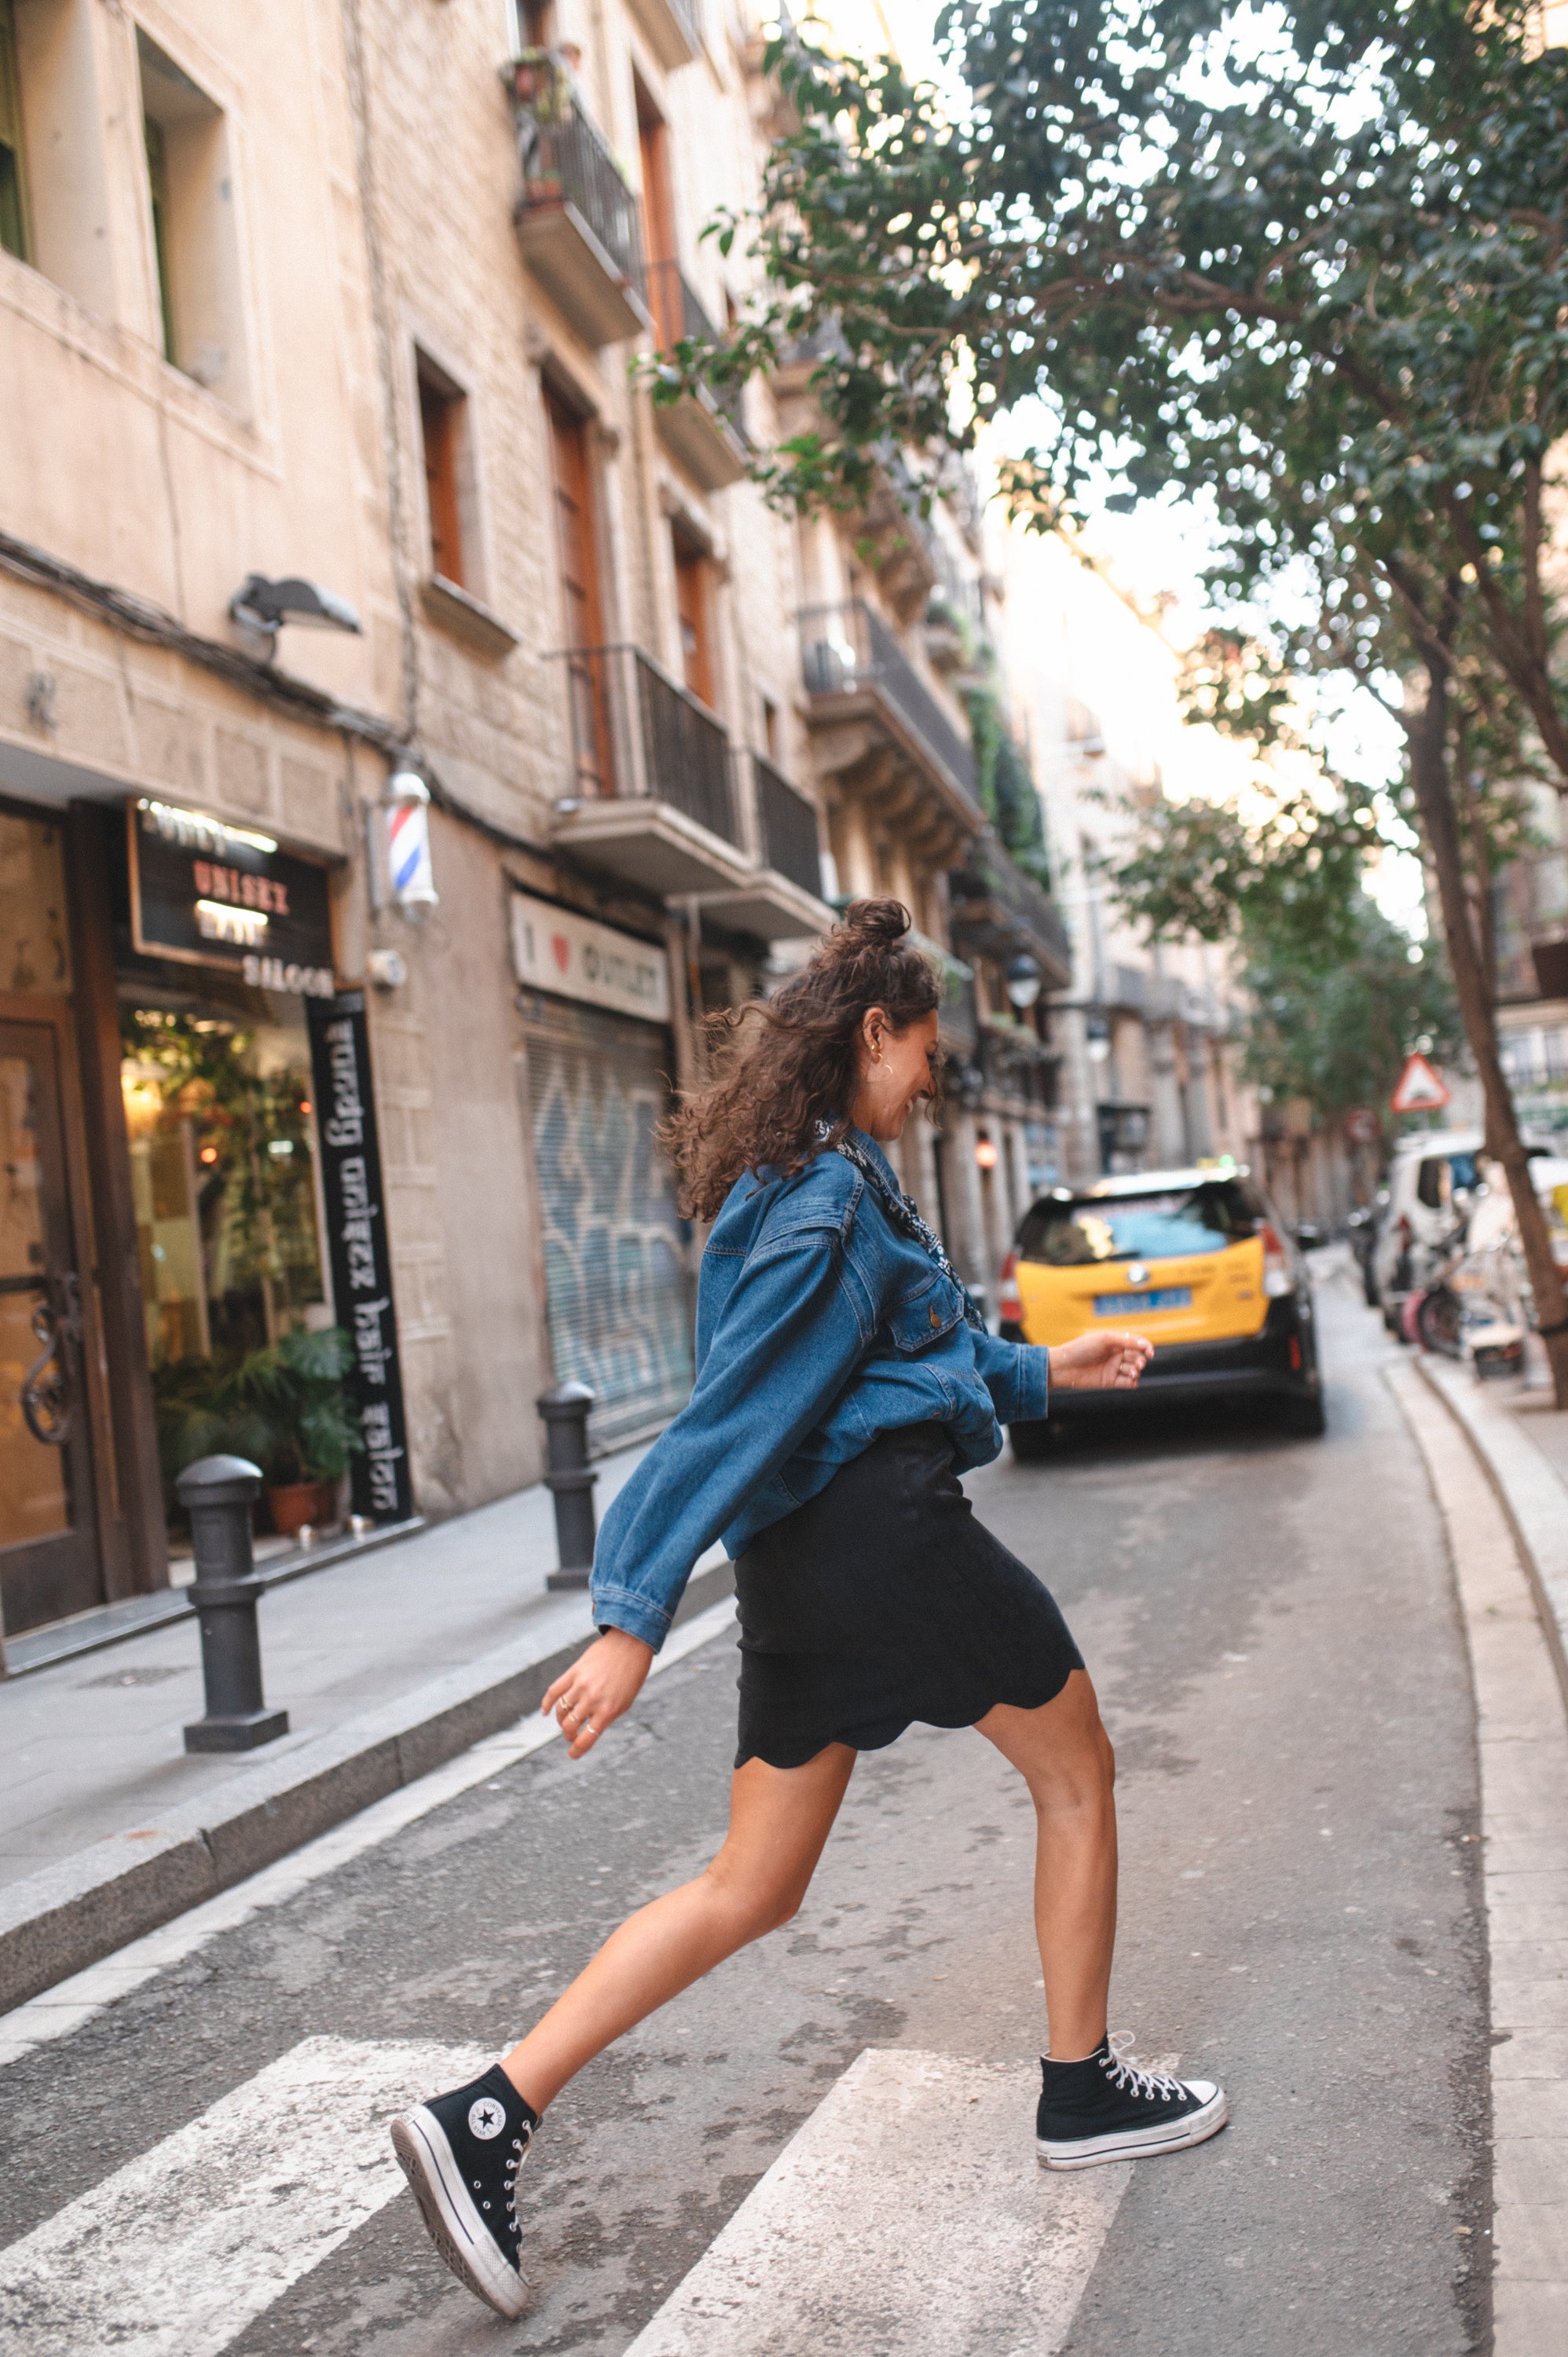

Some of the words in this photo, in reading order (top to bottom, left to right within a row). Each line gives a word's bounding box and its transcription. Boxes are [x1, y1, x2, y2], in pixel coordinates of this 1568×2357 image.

[193, 861, 290, 915] UNISEX
[339, 1157, 378, 1288] unisex
[354, 1298, 391, 1385] hair
[363, 1402, 403, 1510] salon
[473, 2125, 486, 2136] STAR
[483, 2102, 502, 2127] CONVERSE
